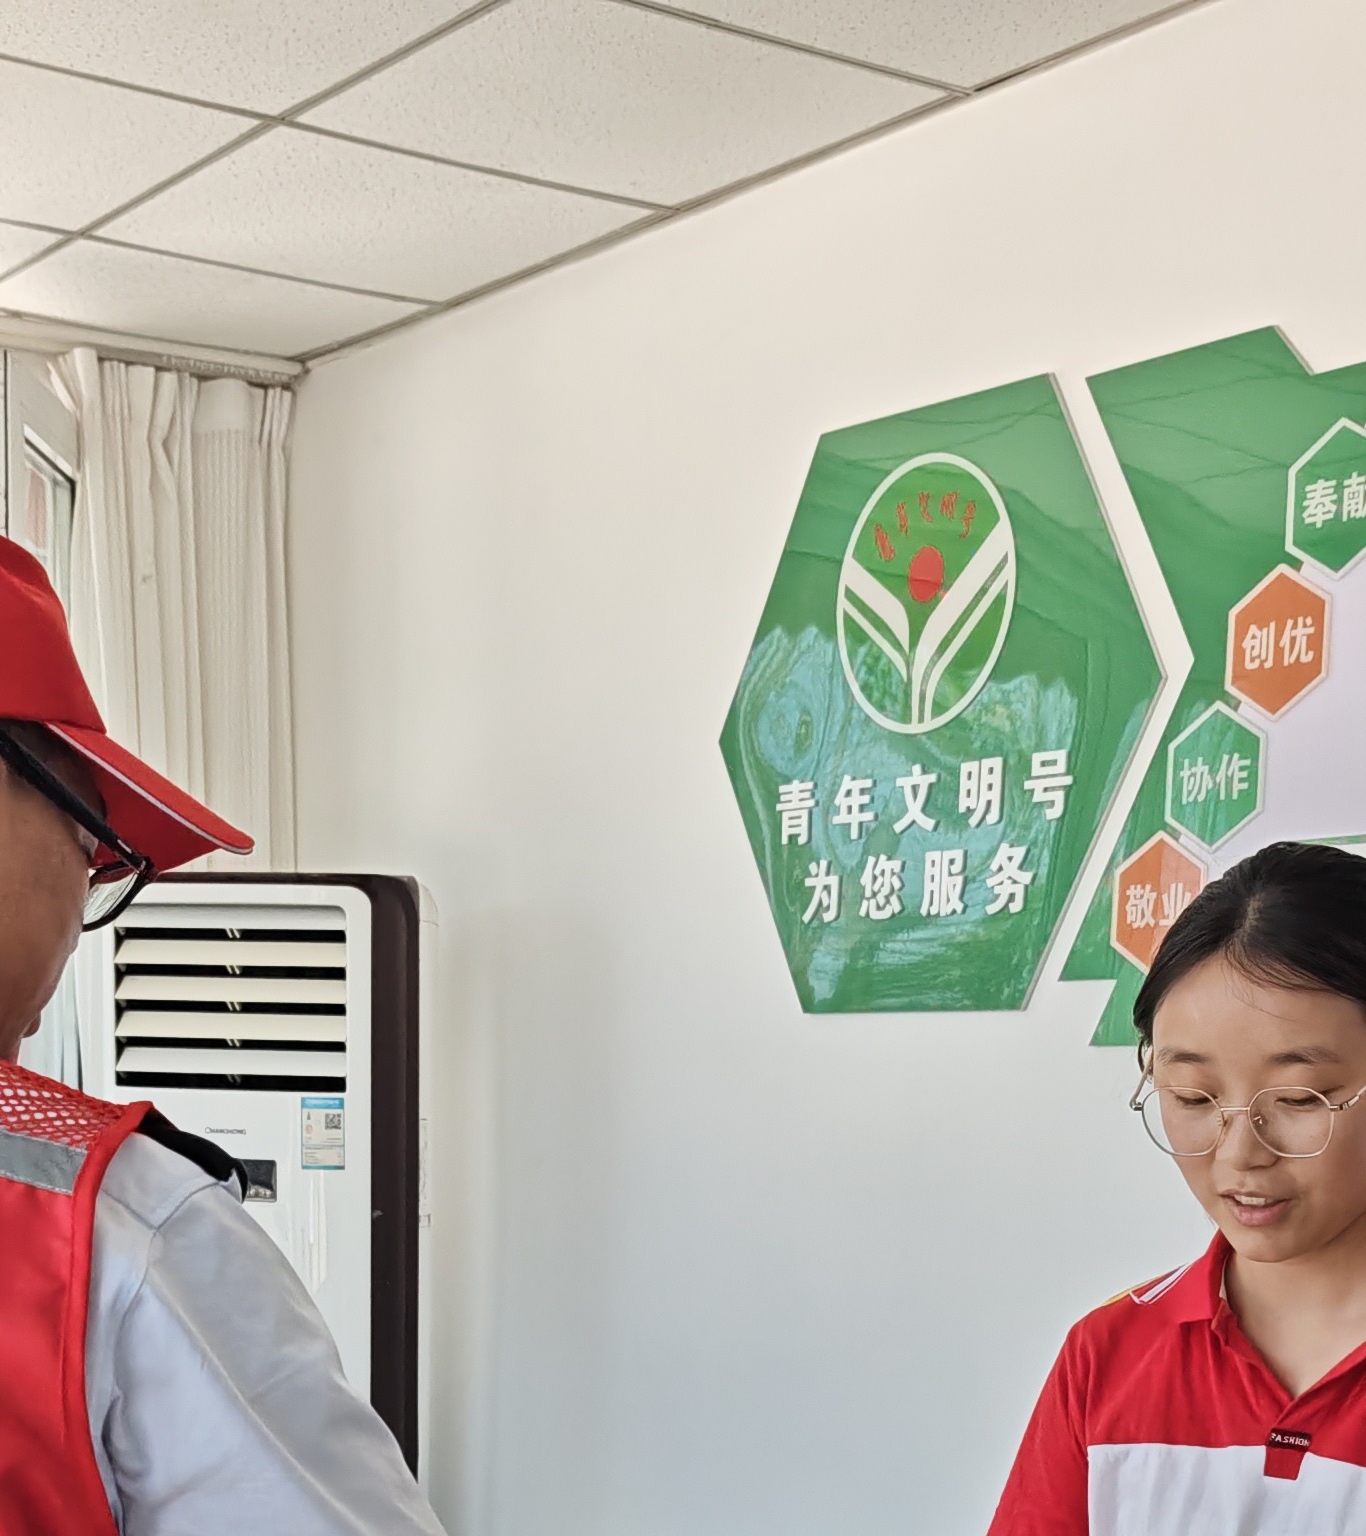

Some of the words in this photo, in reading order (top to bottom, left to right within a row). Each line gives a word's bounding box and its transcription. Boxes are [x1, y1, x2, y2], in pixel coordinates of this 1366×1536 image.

[1242, 616, 1315, 671] 创优
[775, 748, 1073, 846] 青年文明号
[1179, 752, 1252, 804] 协作
[800, 843, 1037, 925] 为您服务
[1124, 882, 1193, 930] 敬业
